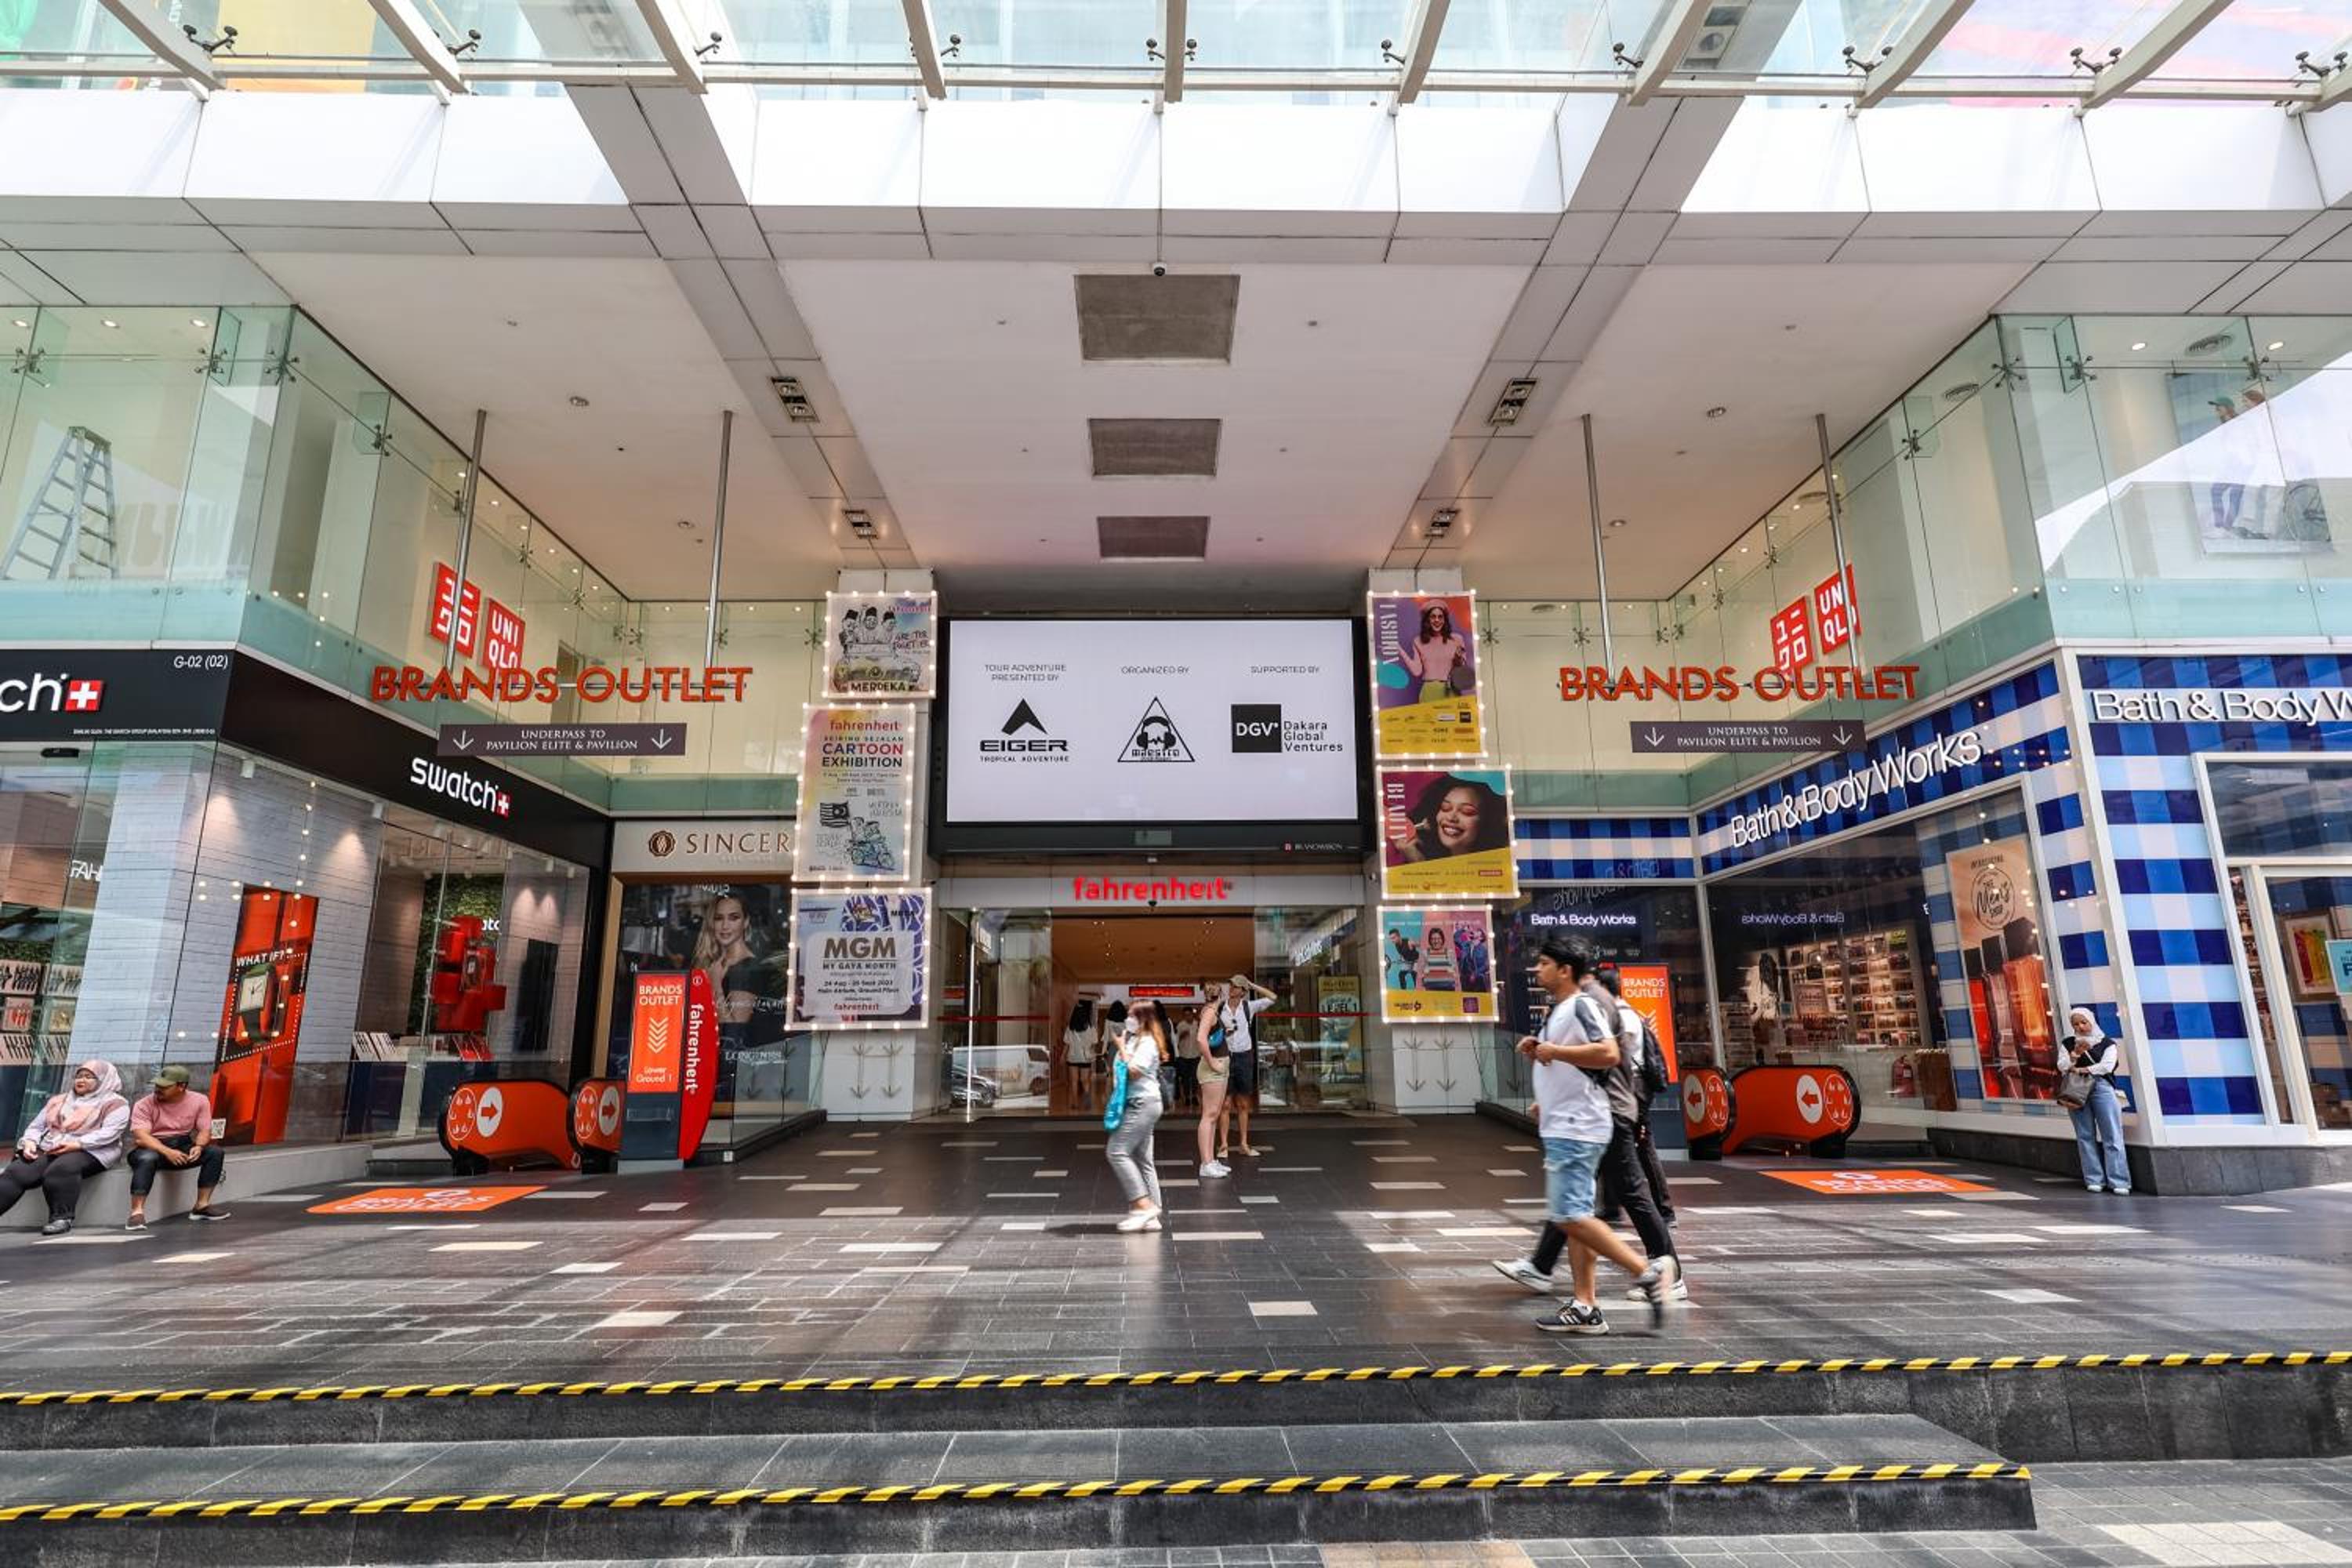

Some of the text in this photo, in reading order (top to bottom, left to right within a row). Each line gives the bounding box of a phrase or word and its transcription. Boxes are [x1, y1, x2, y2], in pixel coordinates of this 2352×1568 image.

[1820, 581, 1844, 615] UN
[492, 610, 519, 648] UNI
[173, 655, 228, 670] G-02 (02)
[1121, 666, 1176, 674] ORGANIZED
[371, 666, 753, 703] BRANDS OUTLET
[851, 681, 906, 693] MERDEKA
[1559, 665, 1920, 702] BRANDS OUTLET
[2090, 690, 2184, 722] Bath
[2187, 691, 2220, 721] &
[2220, 690, 2322, 728] Body
[829, 720, 899, 731] fahrenheit
[1236, 722, 1274, 737] DGV
[1283, 720, 1328, 731] Dakara
[1708, 727, 1788, 736] UNDERPASS TO
[521, 729, 606, 739] UNDERPASS TO
[1283, 731, 1324, 741] Global
[485, 740, 639, 750] PAVILION ELITE & PAVILION
[980, 739, 1069, 752] EIGER
[1284, 742, 1344, 752] Ventures
[1676, 736, 1822, 746] PAVILION ELITE & PAVILION
[822, 743, 904, 756] CARTOON
[822, 757, 903, 768] EXHIBITION
[410, 757, 499, 815] swatch
[1730, 731, 1983, 848] Bath & Body Works
[686, 833, 791, 854] SINCER
[1073, 876, 1228, 901] fahrenheit
[1530, 913, 1637, 927] Bath & Body Works
[824, 937, 896, 959] MGM
[236, 949, 286, 967] WHAT IF?
[1623, 978, 1666, 987] BRANDS
[639, 985, 683, 995] BRANDS
[1624, 988, 1664, 998] OUTLET
[639, 995, 681, 1006] OUTLET
[685, 1003, 704, 1091] fahrenheit
[636, 1074, 666, 1083] Ground
